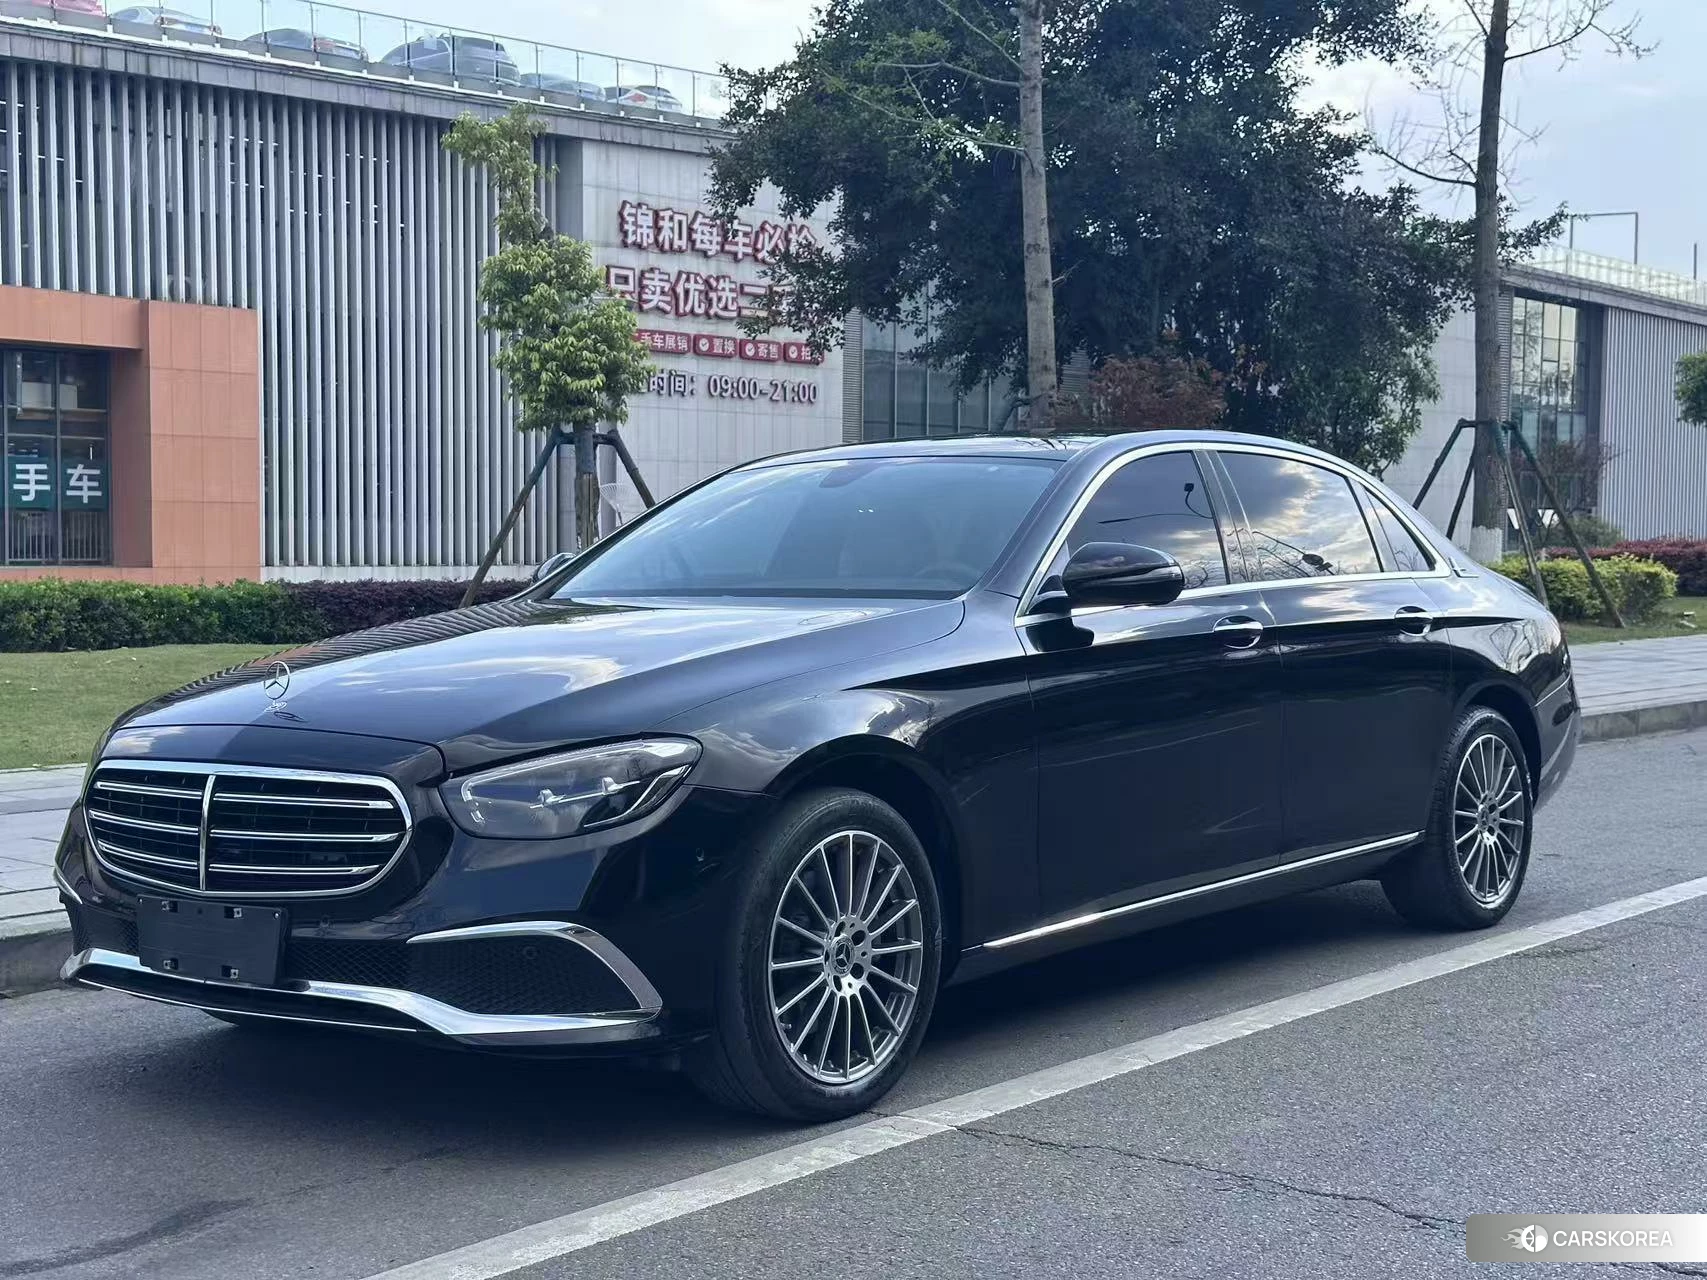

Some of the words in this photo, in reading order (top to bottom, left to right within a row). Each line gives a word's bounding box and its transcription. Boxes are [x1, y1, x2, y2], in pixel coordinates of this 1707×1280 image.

[632, 331, 689, 352] 手车展销
[713, 338, 735, 354] 置换
[801, 345, 823, 361] 拍
[708, 375, 817, 403] 09:00-21:00
[13, 464, 102, 503] 手车
